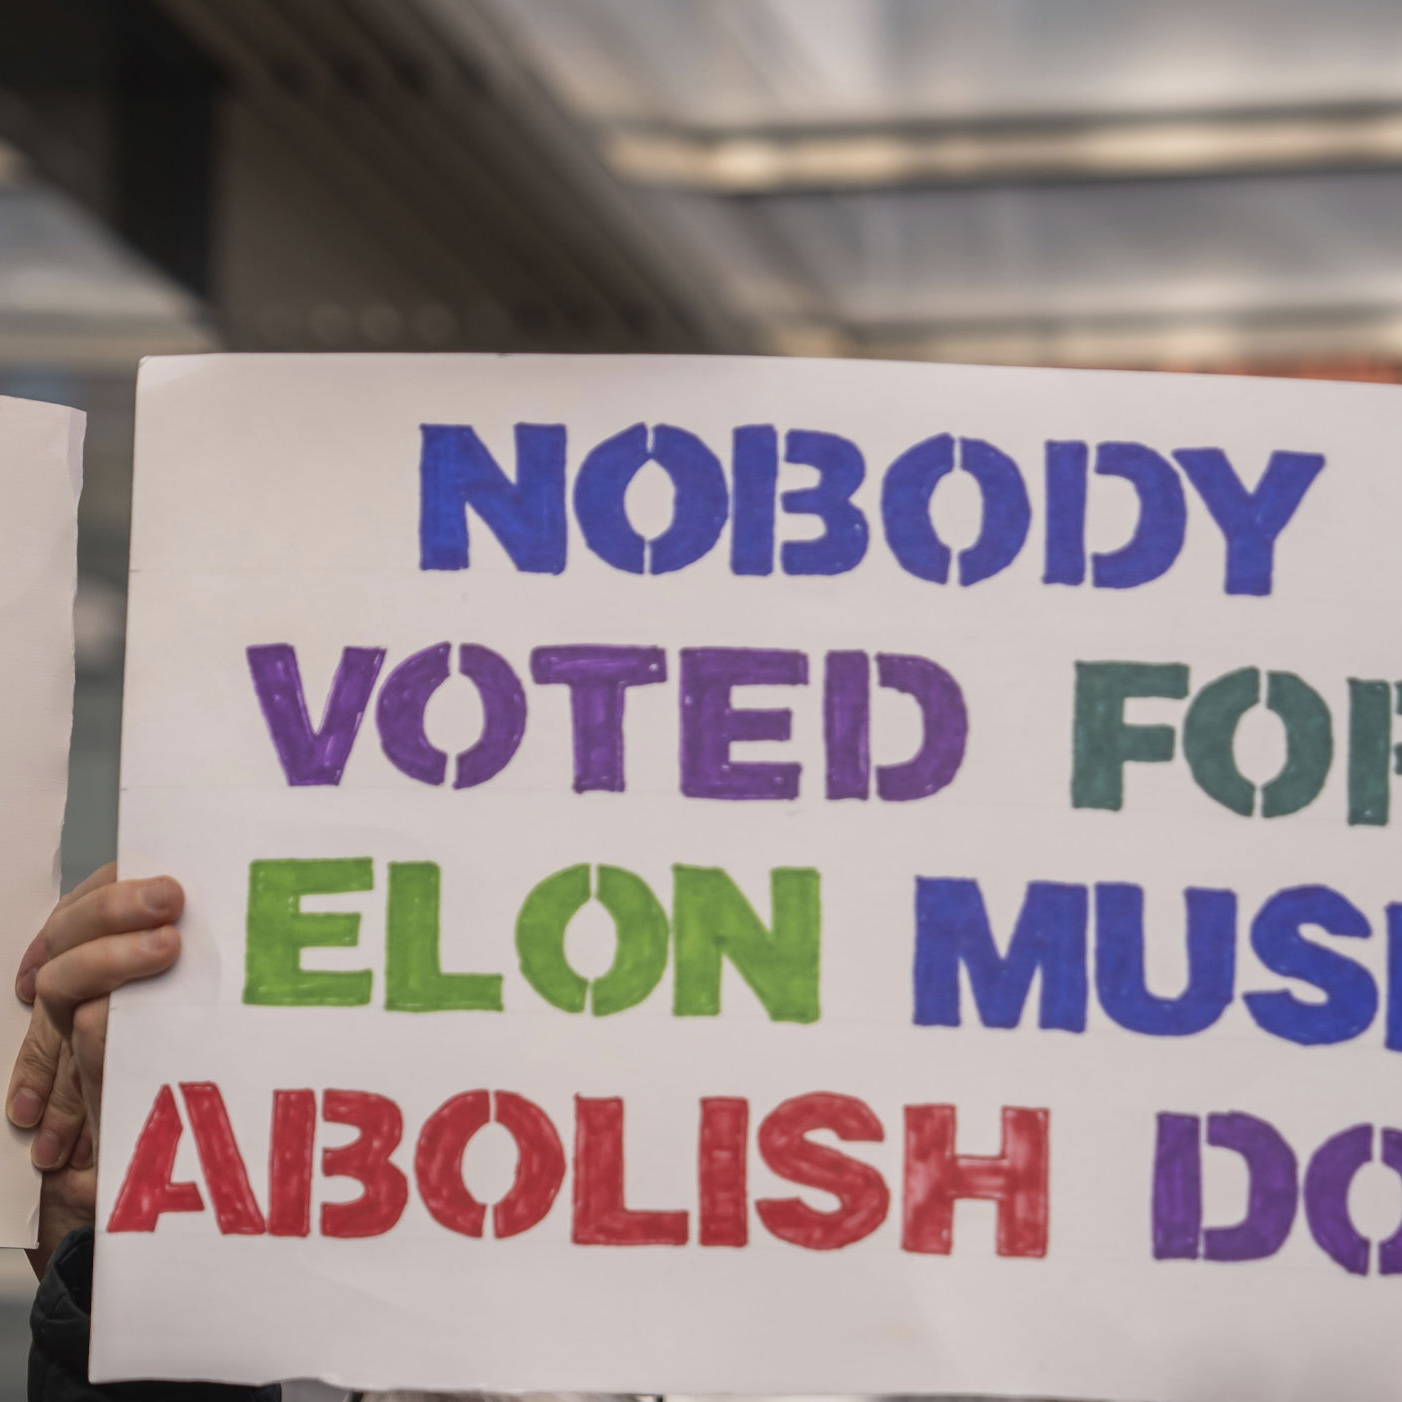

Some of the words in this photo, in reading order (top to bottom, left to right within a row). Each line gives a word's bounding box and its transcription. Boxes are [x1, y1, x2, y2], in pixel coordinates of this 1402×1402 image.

[421, 424, 1323, 595] NOBODY
[249, 645, 966, 800] VOTED
[244, 858, 820, 1024] ELON
[107, 1082, 1049, 1258] ABOLISH
